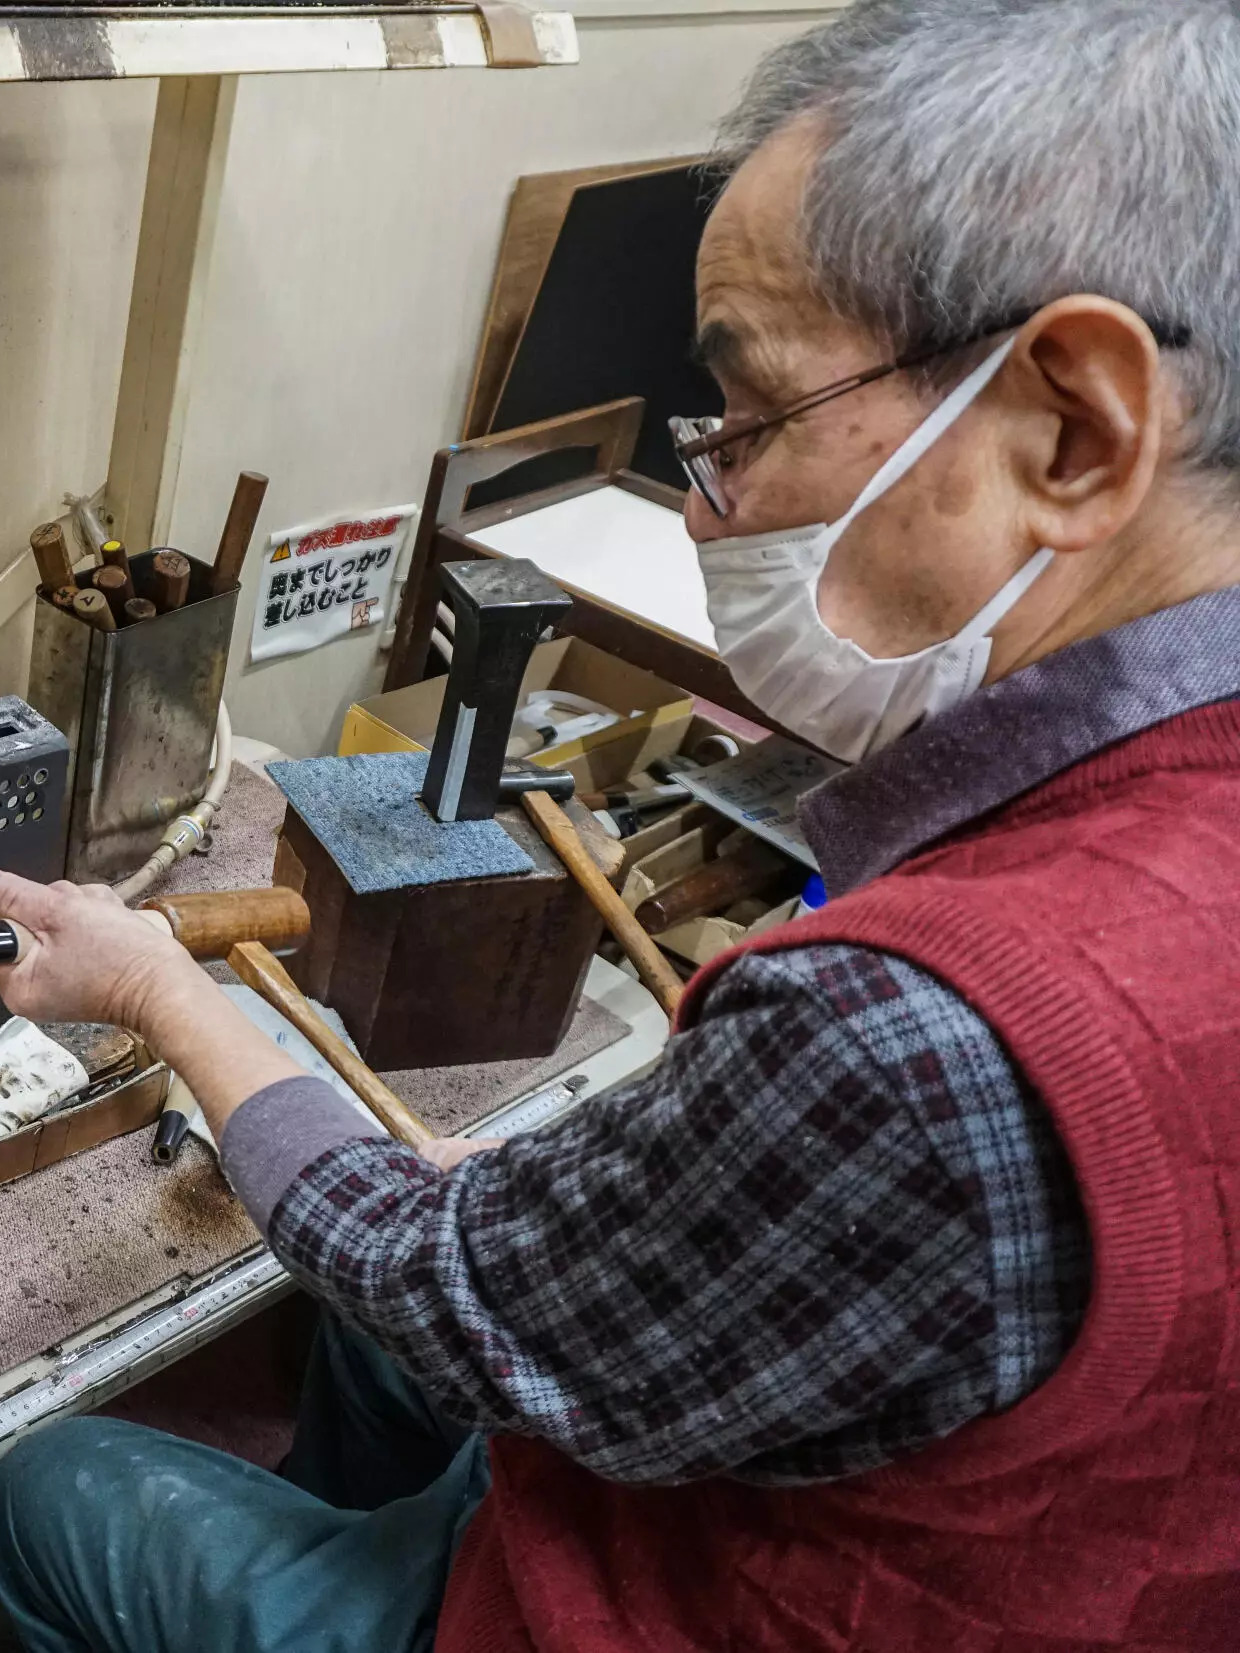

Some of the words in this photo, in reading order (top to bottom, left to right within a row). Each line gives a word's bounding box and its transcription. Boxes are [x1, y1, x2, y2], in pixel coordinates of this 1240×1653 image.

[269, 546, 392, 600] 奥までしっかり
[264, 577, 368, 629] 差し込むこと
